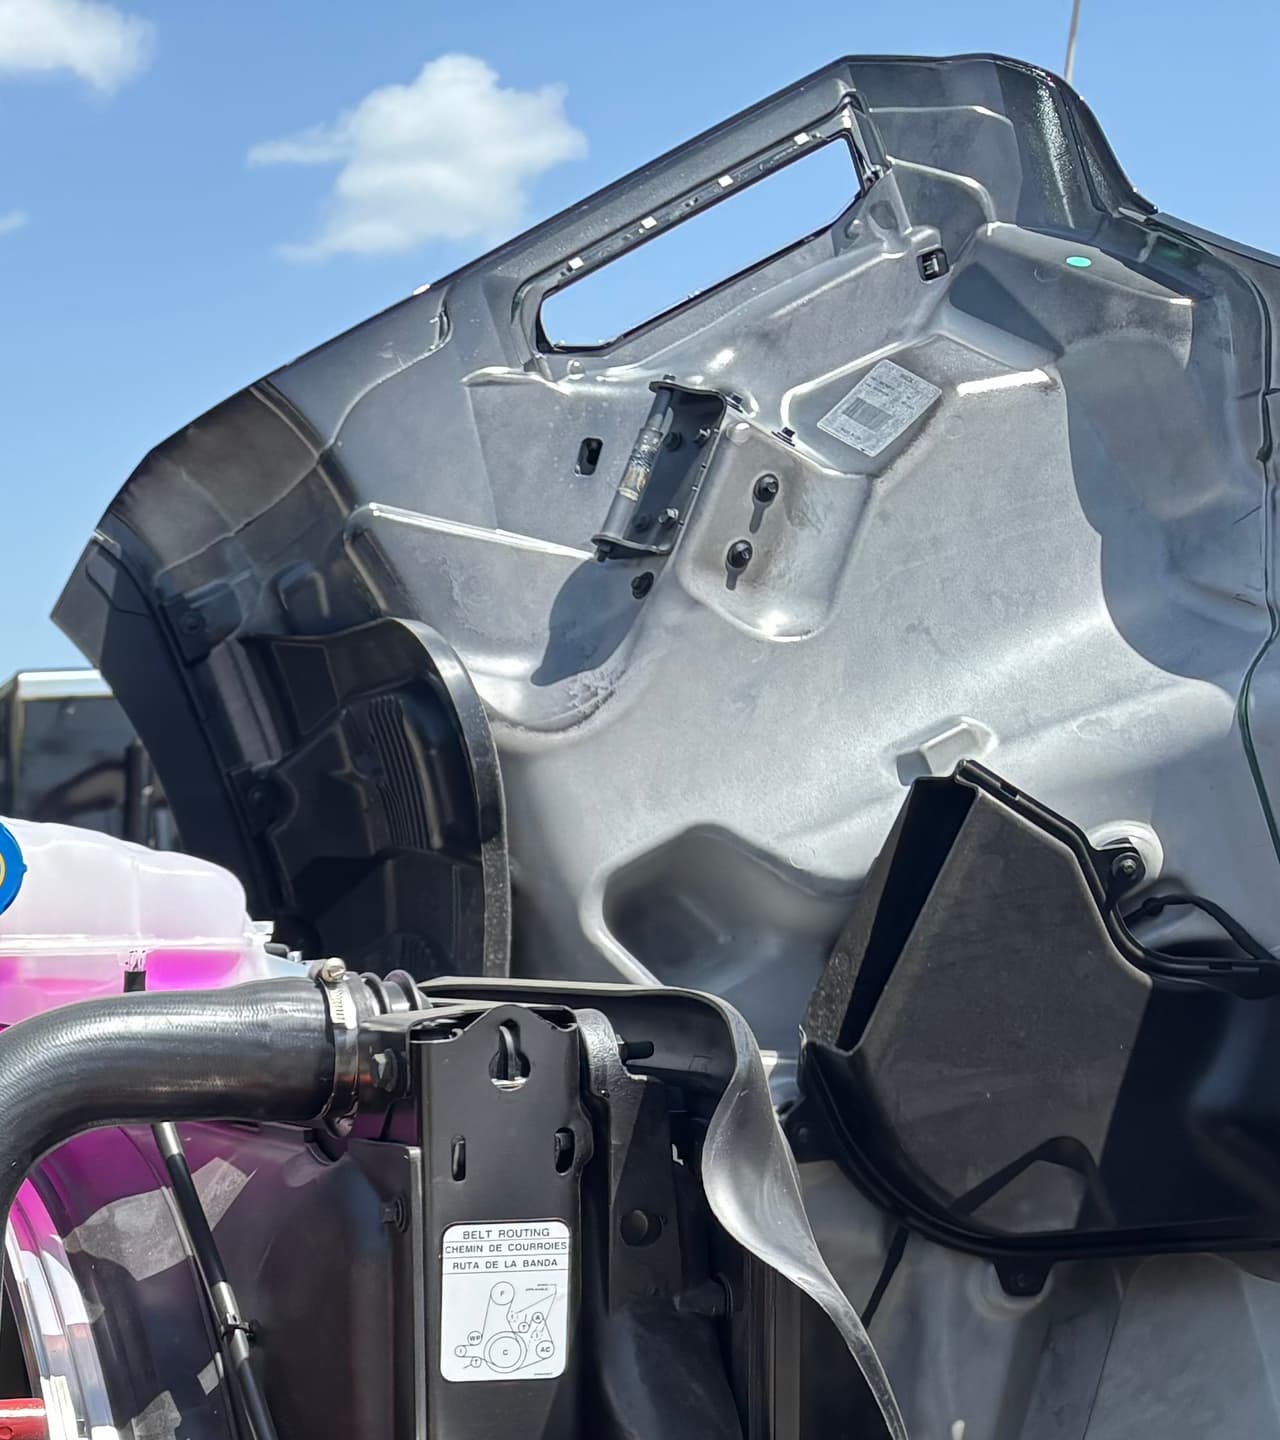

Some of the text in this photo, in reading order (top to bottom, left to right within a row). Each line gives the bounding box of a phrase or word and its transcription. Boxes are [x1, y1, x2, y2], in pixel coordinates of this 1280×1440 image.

[462, 1228, 550, 1240] BELT ROUTING
[445, 1242, 567, 1254] CHEMIN DE COURROIES
[452, 1258, 558, 1270] RUTA DE LA BANDA
